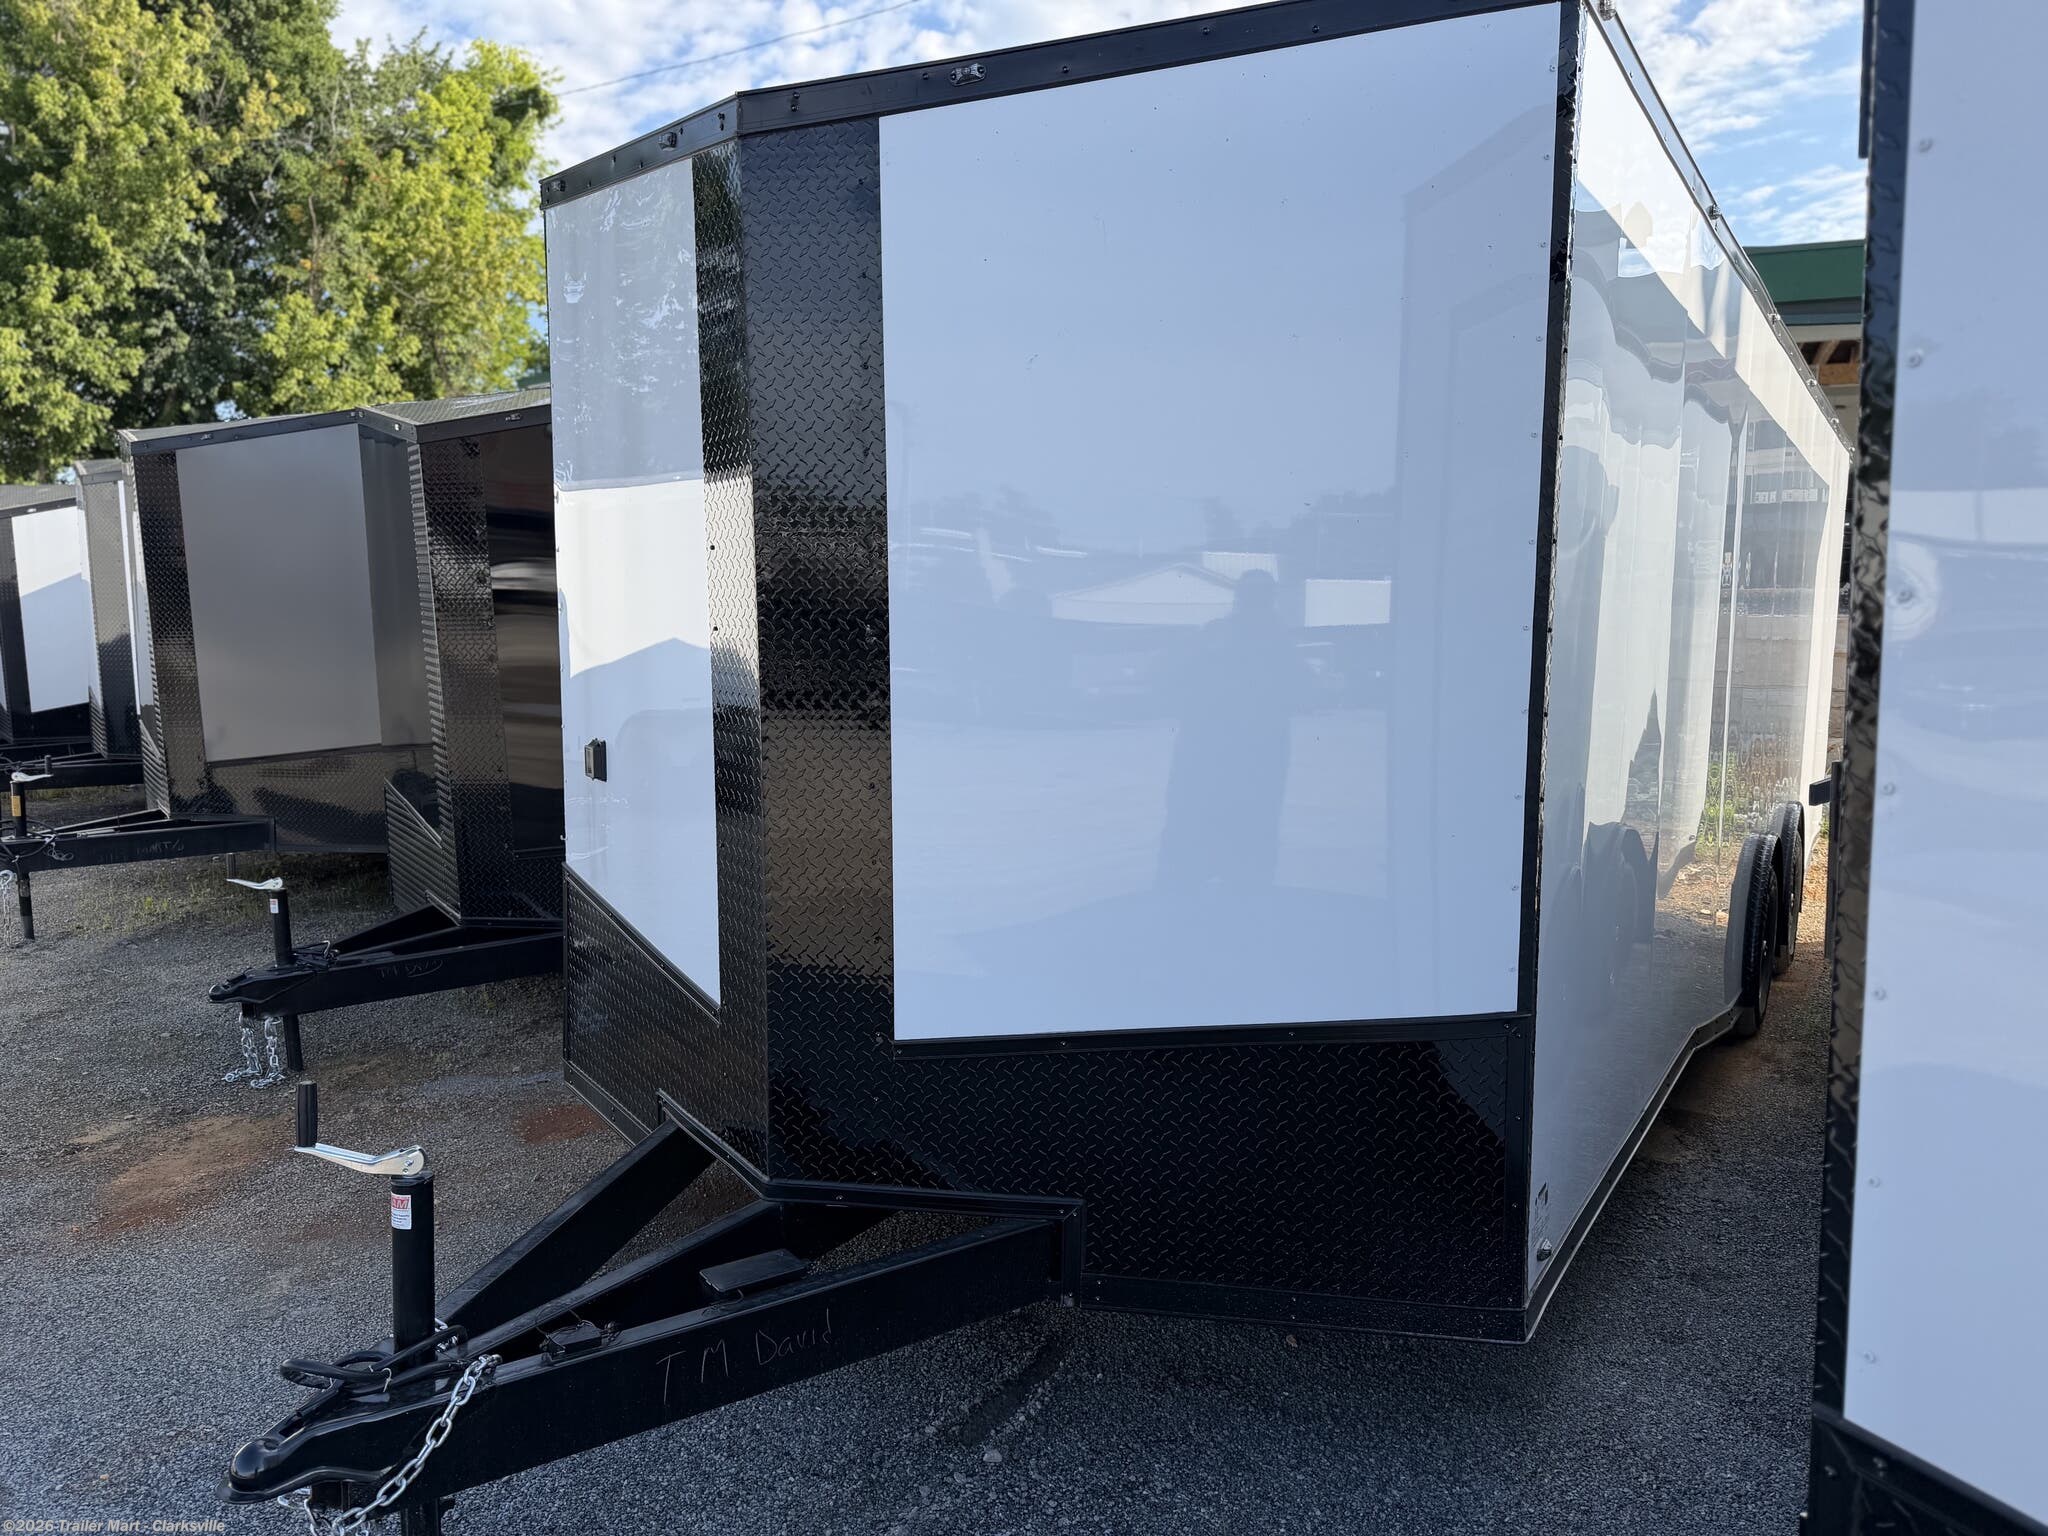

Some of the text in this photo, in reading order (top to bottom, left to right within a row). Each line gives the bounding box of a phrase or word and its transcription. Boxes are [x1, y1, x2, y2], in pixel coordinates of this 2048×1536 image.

[656, 1306, 833, 1405] T M David
